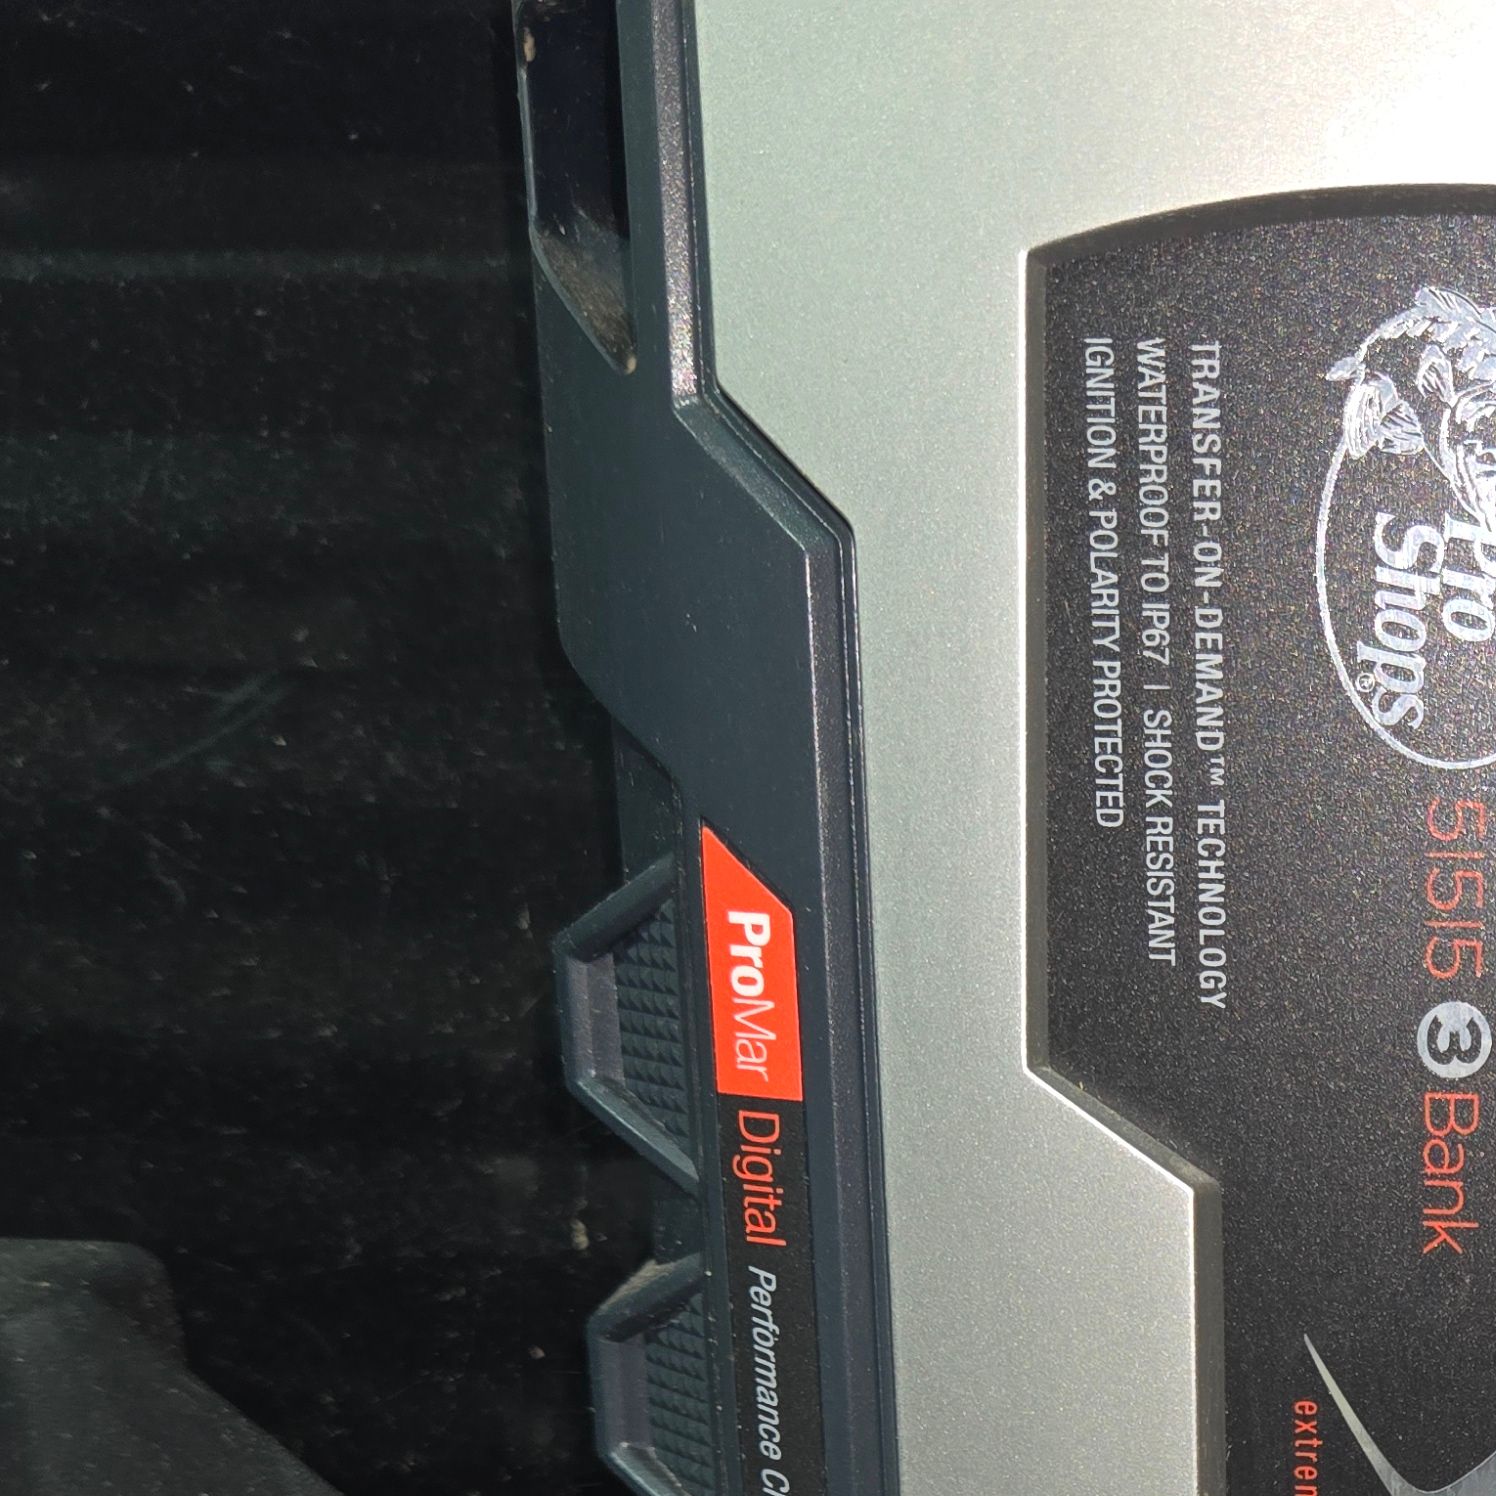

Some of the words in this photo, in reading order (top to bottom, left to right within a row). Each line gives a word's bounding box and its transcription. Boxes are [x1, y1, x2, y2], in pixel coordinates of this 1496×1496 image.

[1084, 337, 1116, 468] IGNITION
[1136, 337, 1168, 545] WATERPROOF
[1087, 477, 1119, 502] &
[1088, 510, 1121, 652] POLARITY
[1140, 555, 1169, 592] TO
[1141, 602, 1170, 665] IP67
[1093, 660, 1124, 828] PROTECTED
[1143, 708, 1174, 807] SHOCK
[1145, 816, 1176, 966] RESISTANT
[1195, 800, 1227, 1009] TECHNOLOGY
[727, 911, 779, 1083] ProMar
[732, 1110, 787, 1246] Digital
[1421, 1091, 1480, 1255] Bank
[745, 1266, 784, 1458] Performance
